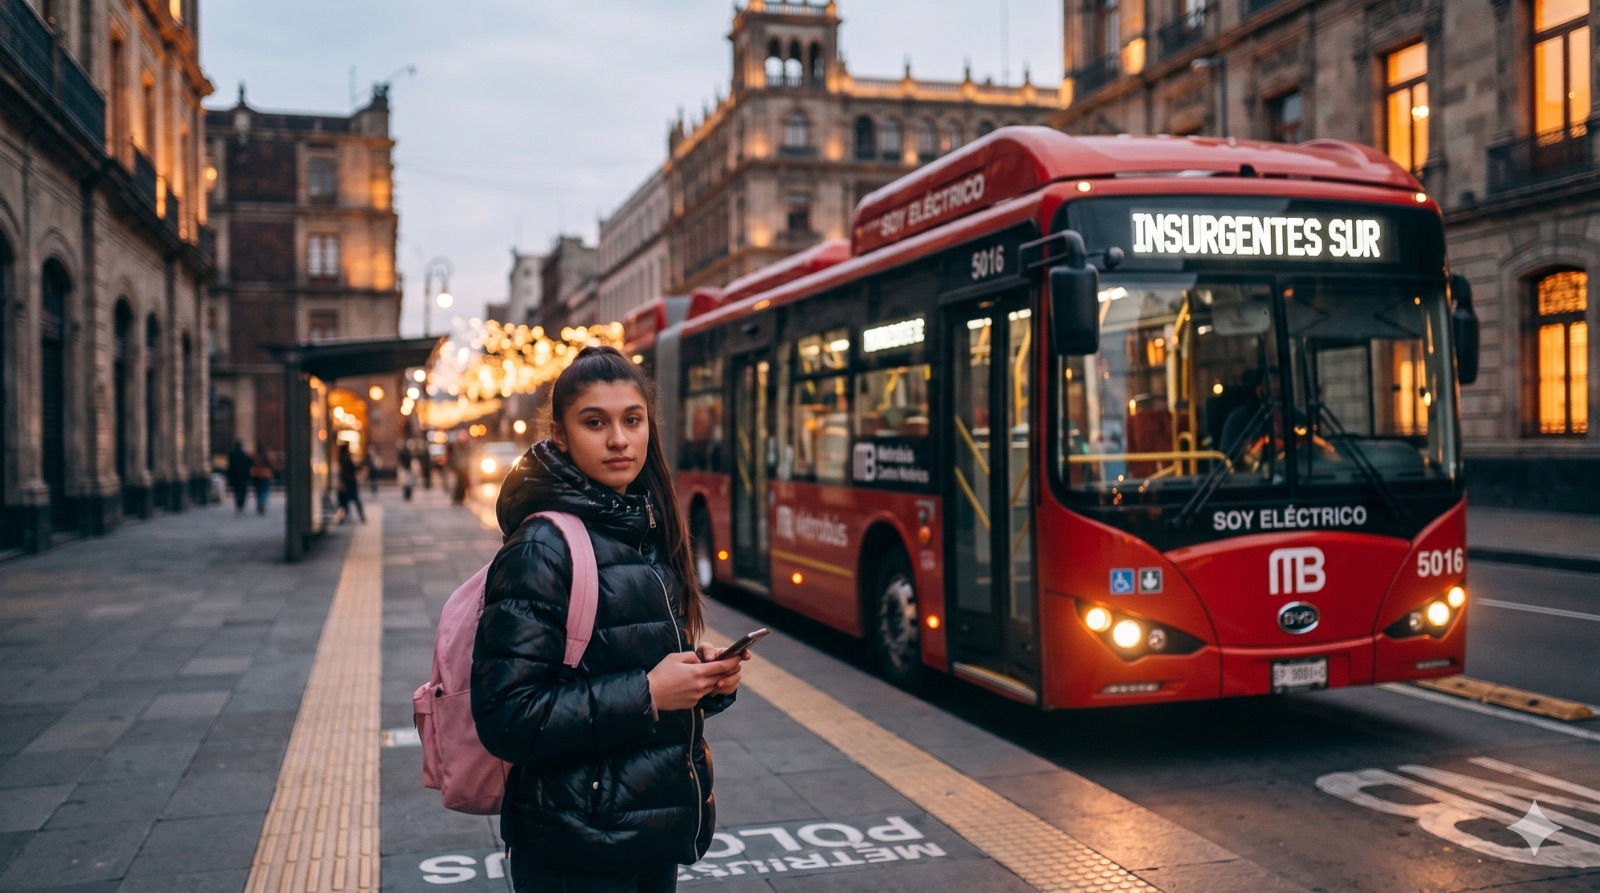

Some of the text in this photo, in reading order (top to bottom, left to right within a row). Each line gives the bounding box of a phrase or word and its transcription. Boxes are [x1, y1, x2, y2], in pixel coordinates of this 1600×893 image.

[1132, 213, 1381, 258] INSURGENTES SUR
[971, 244, 1005, 280] 5016
[1213, 504, 1368, 531] SOY ELÉCTRICO
[1416, 547, 1464, 578] 5016
